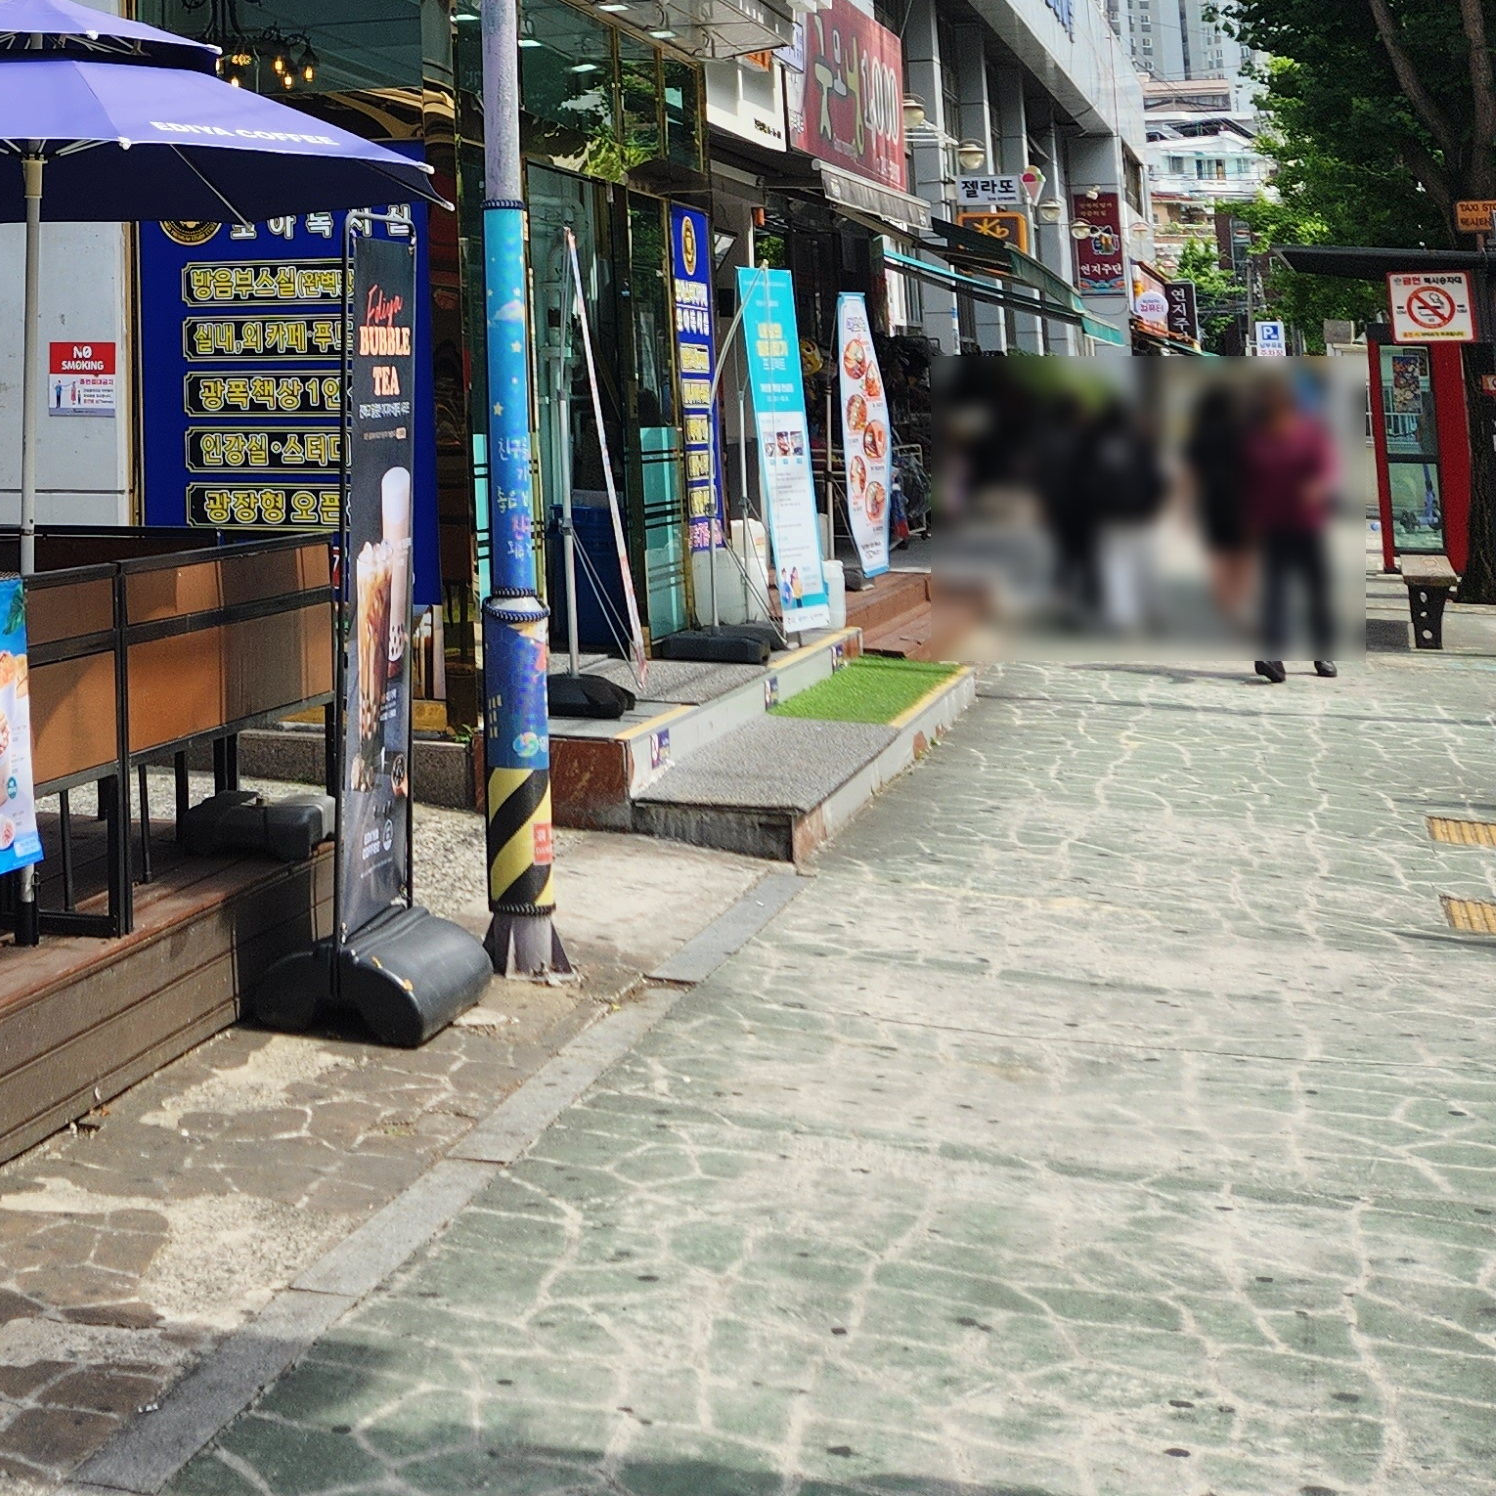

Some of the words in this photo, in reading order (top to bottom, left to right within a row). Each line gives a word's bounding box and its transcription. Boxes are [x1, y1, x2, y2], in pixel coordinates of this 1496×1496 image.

[149, 121, 236, 137] EDIYA
[235, 129, 341, 146] COFFEE
[961, 179, 1017, 199] 젤라또
[1459, 203, 1479, 212] TAXI
[1171, 288, 1191, 341] 연지주
[73, 345, 92, 359] NO
[194, 321, 264, 355] 실내,외
[360, 325, 411, 356] BUBBLE
[61, 360, 104, 371] SMOKING
[199, 377, 303, 411] 광폭책상
[372, 366, 401, 396] TEA
[205, 488, 286, 524] 광장형
